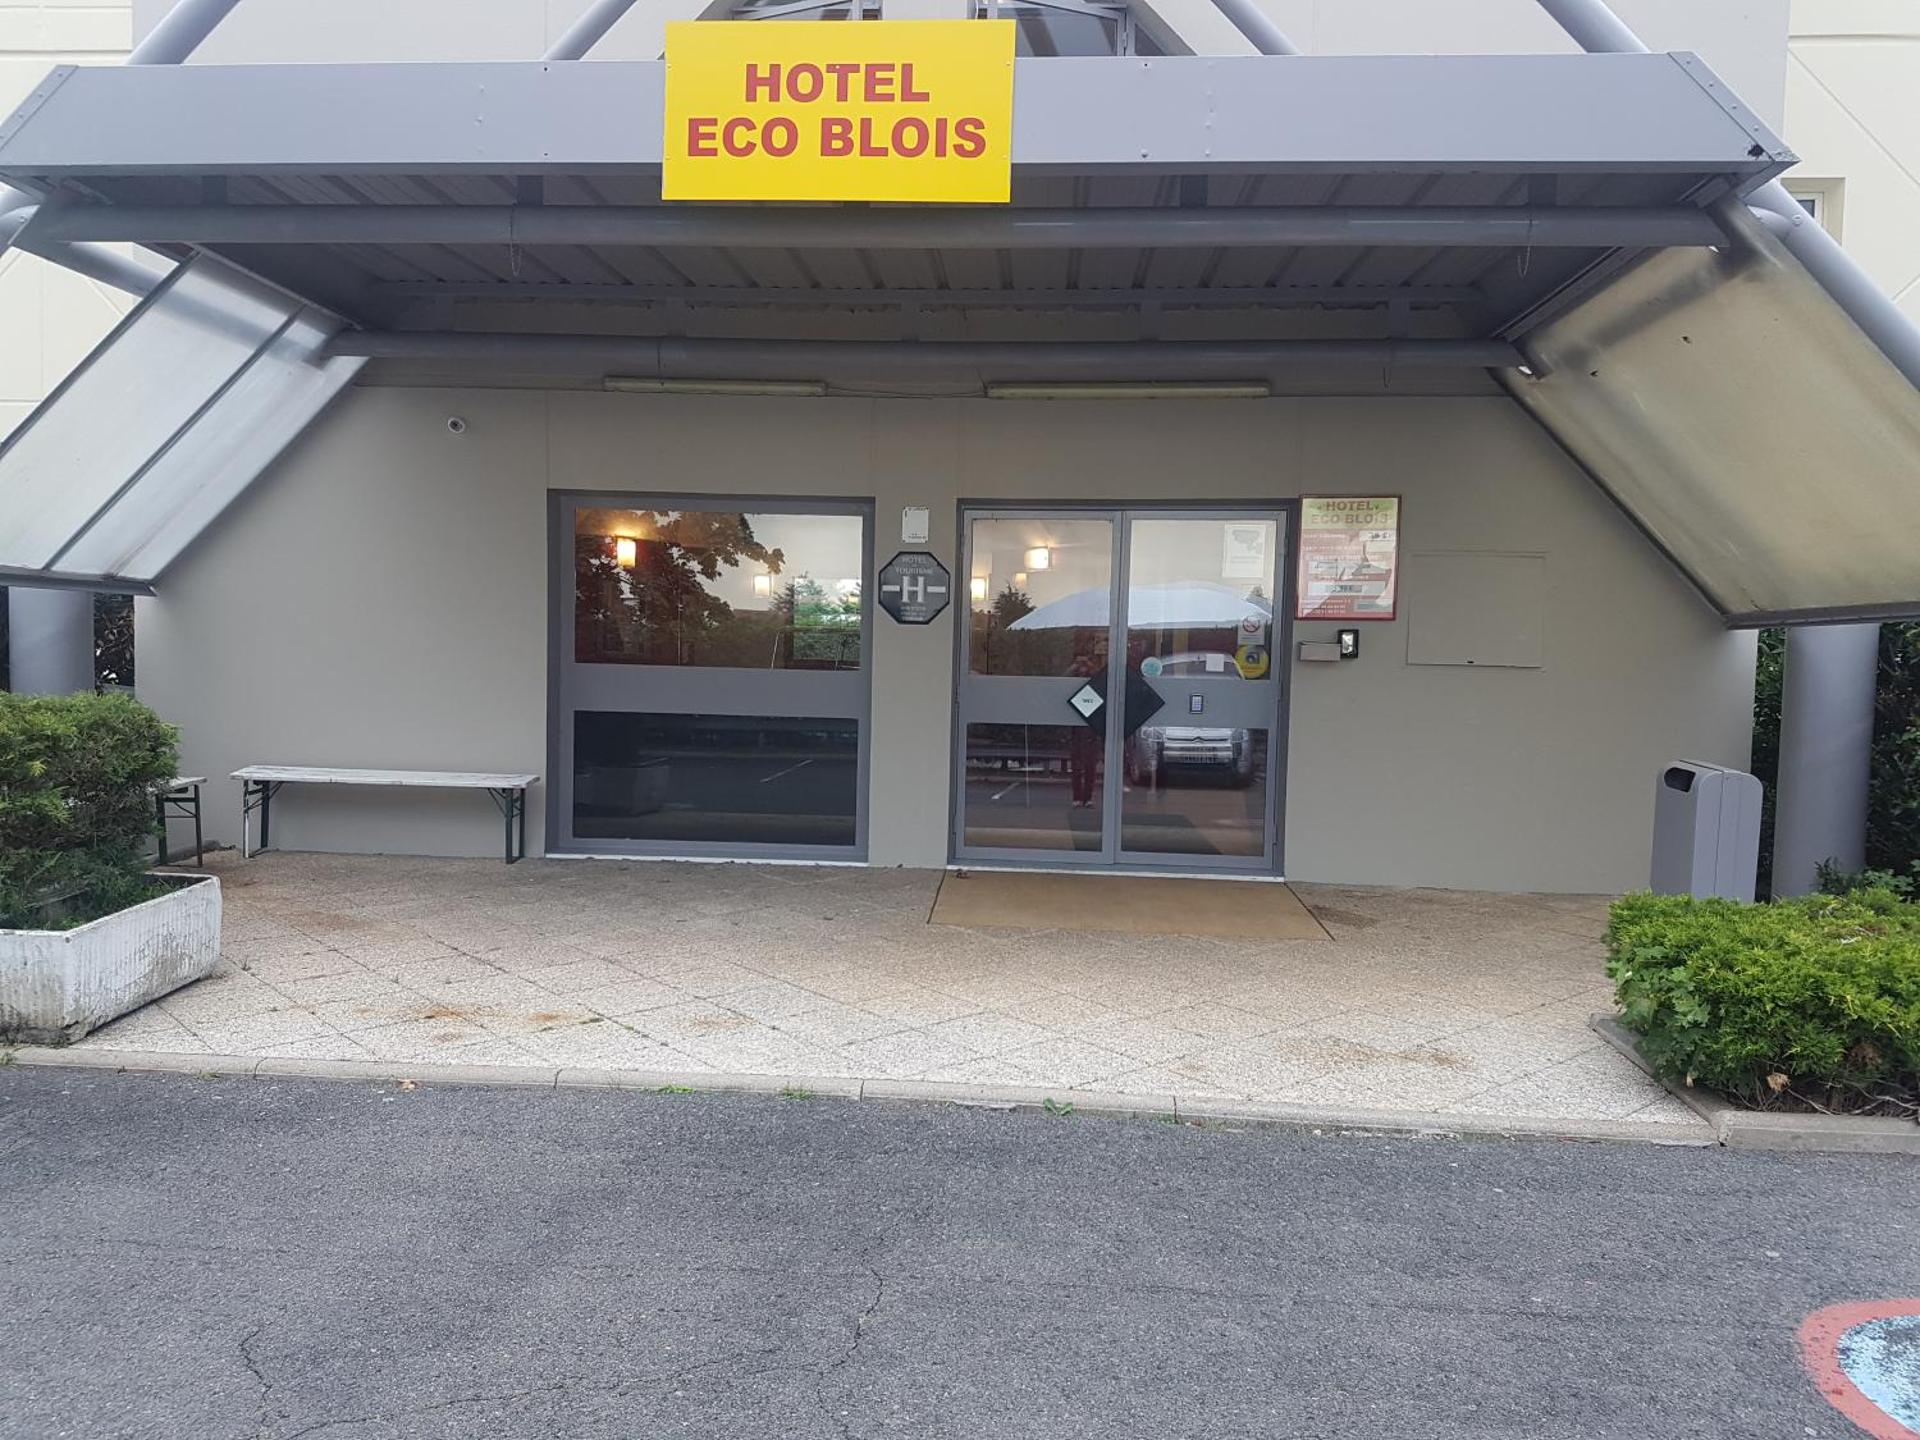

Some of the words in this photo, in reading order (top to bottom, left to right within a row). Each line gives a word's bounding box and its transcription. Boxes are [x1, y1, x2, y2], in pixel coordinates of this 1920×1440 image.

[746, 64, 929, 102] HOTEL
[688, 118, 798, 157] ECO
[821, 118, 986, 158] BLOIS
[1311, 514, 1340, 524] ECO
[1344, 513, 1388, 524] BLOIS
[1326, 501, 1374, 512] HOTEL
[902, 576, 925, 603] H
